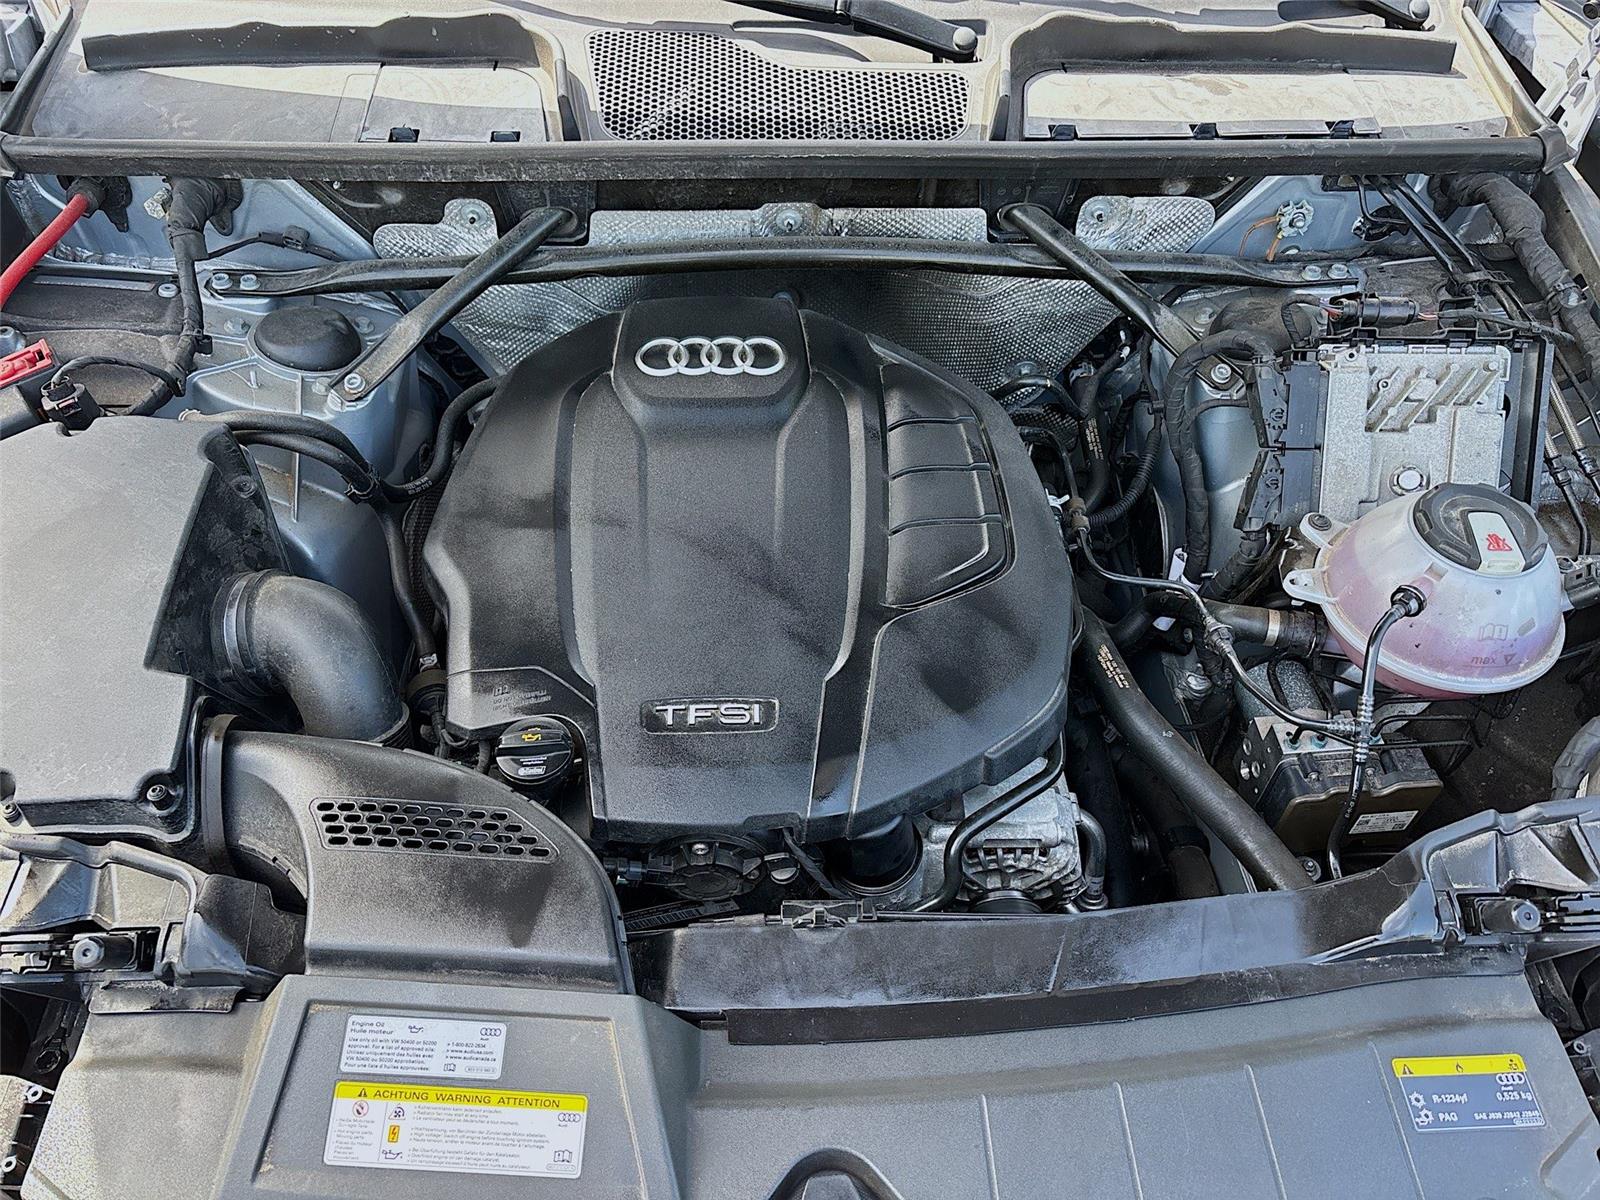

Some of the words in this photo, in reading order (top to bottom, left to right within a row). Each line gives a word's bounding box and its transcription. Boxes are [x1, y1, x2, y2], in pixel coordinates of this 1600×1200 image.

[1471, 656, 1497, 665] max
[656, 703, 760, 726] TFSI
[373, 1090, 429, 1100] ACHTUNG
[436, 1093, 491, 1104] WARNING
[497, 1096, 560, 1108] ATTENTION
[1496, 1091, 1520, 1102] 0,525
[1520, 1091, 1532, 1101] kg
[1438, 1113, 1458, 1122] PAG
